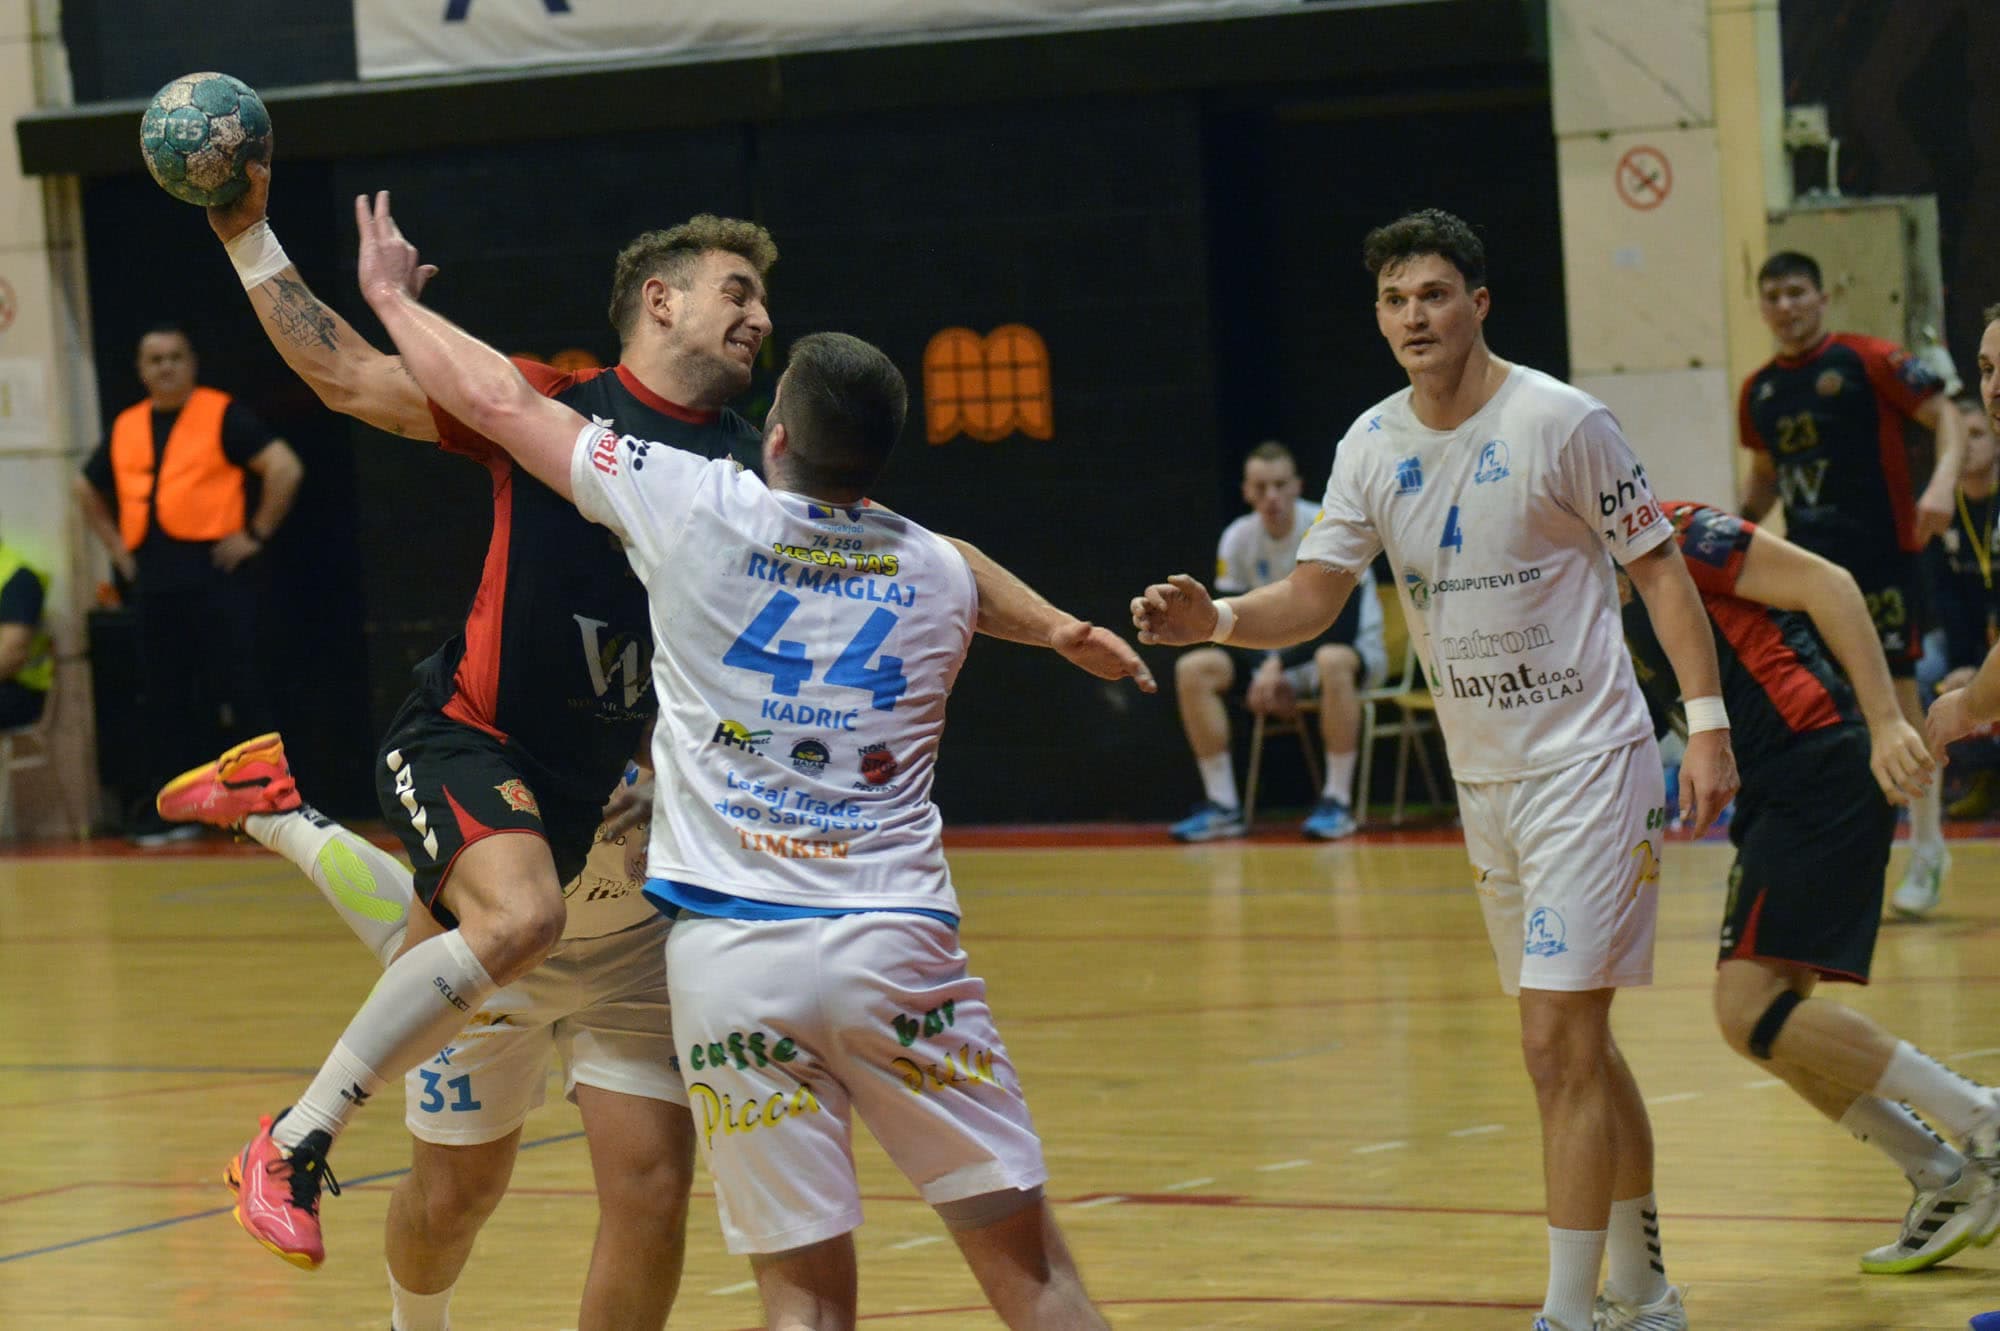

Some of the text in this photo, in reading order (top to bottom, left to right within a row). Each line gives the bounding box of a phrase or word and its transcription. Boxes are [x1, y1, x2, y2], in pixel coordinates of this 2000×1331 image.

[812, 535, 862, 550] 74 250
[1439, 504, 1463, 553] 4
[773, 543, 899, 576] MEGA TAS
[1518, 567, 1541, 584] DD
[747, 552, 916, 608] RK MAGLAJ
[723, 589, 908, 712] 44
[1448, 663, 1580, 708] hayat d.o.o.
[1499, 680, 1584, 710] MAGLAJ
[760, 698, 859, 731] KADRIĆ
[714, 798, 761, 821] doo
[726, 770, 861, 817] Ložaj Trade
[734, 826, 851, 859] TIMKEN
[433, 976, 470, 1011] SELECT
[420, 1068, 482, 1113] 31
